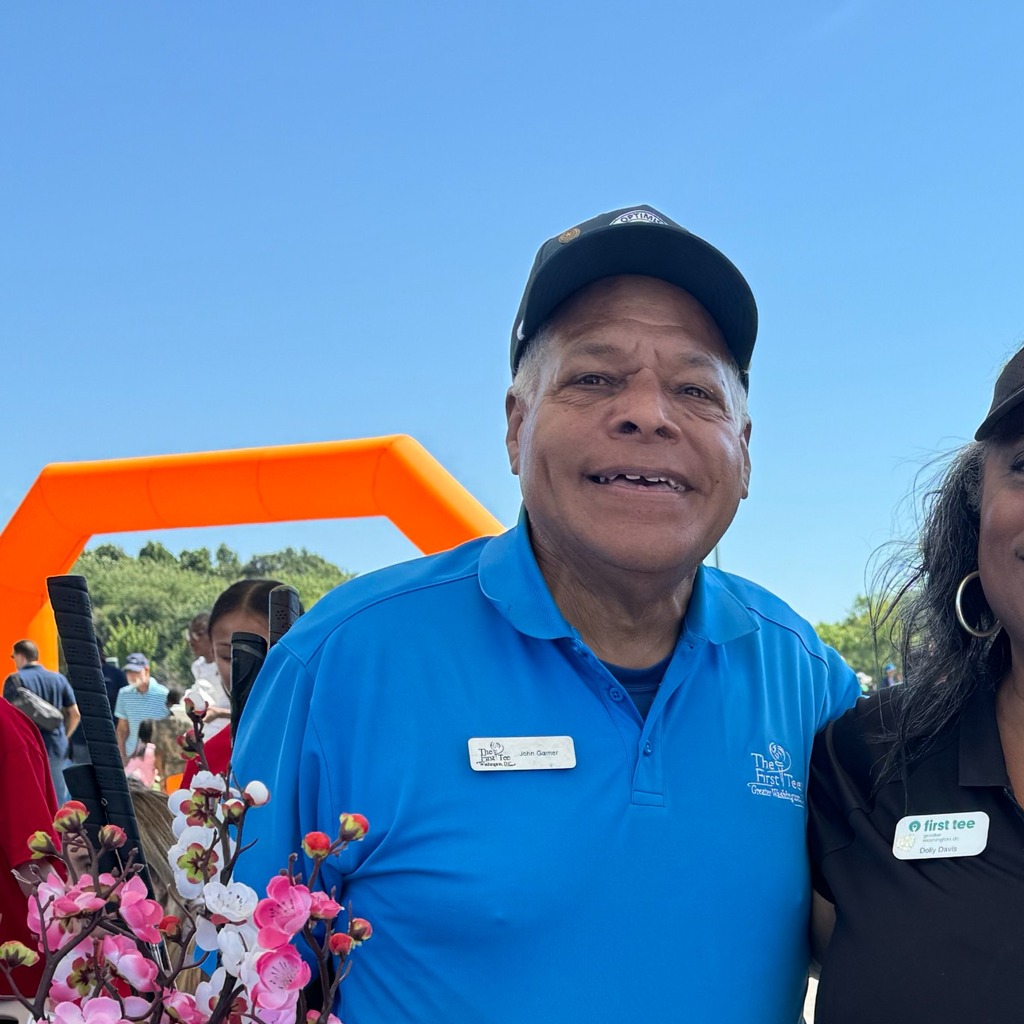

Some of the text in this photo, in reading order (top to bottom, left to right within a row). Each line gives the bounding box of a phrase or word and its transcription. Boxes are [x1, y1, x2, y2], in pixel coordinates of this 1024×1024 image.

[751, 752, 775, 770] The
[755, 767, 780, 786] First
[924, 819, 976, 832] first tee
[919, 846, 936, 854] Dolly
